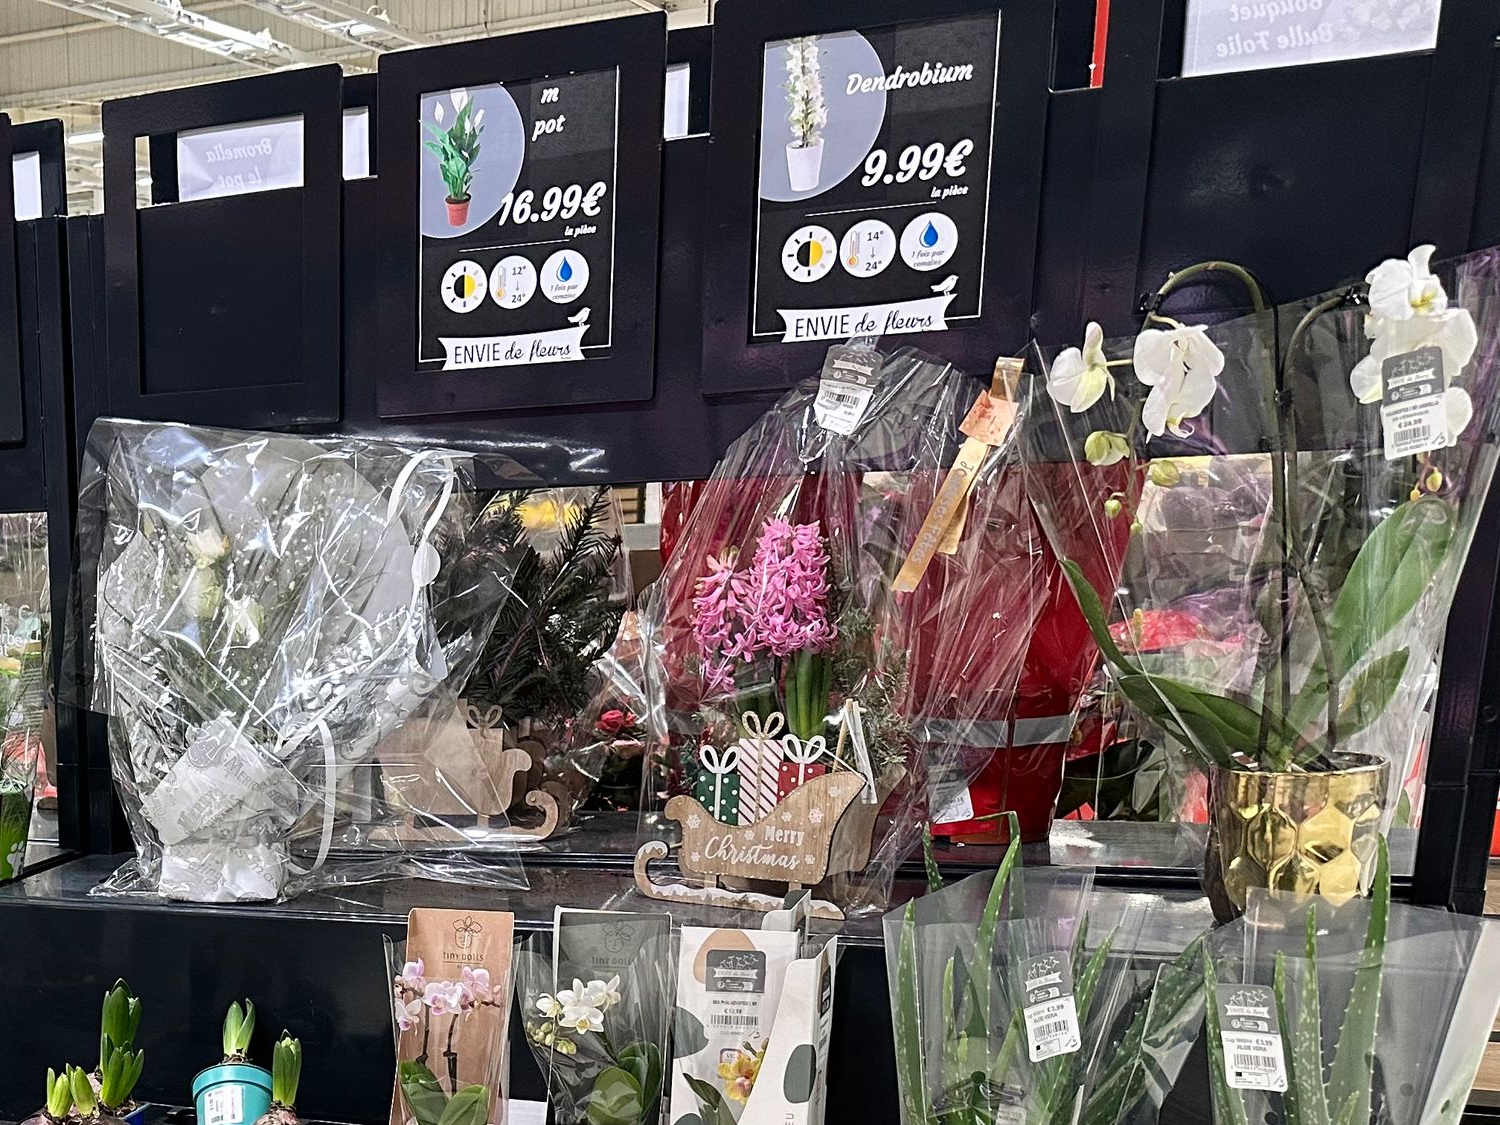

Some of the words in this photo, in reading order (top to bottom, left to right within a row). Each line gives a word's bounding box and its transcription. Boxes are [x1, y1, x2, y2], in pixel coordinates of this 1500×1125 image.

[846, 62, 973, 95] Dendrobium
[532, 115, 565, 140] pot
[861, 139, 973, 186] 9.99€
[499, 181, 606, 226] 16.99€
[931, 187, 940, 198] la
[942, 185, 968, 200] pièce
[867, 230, 884, 241] 14°
[865, 260, 882, 271] 24°
[795, 314, 849, 338] ENVIE
[854, 312, 877, 333] de
[884, 310, 933, 335] fleurs
[454, 343, 501, 364] ENVIE
[504, 341, 524, 360] de
[529, 339, 571, 361] fleurs
[764, 825, 805, 846] Merry
[704, 834, 800, 871] Christmas
